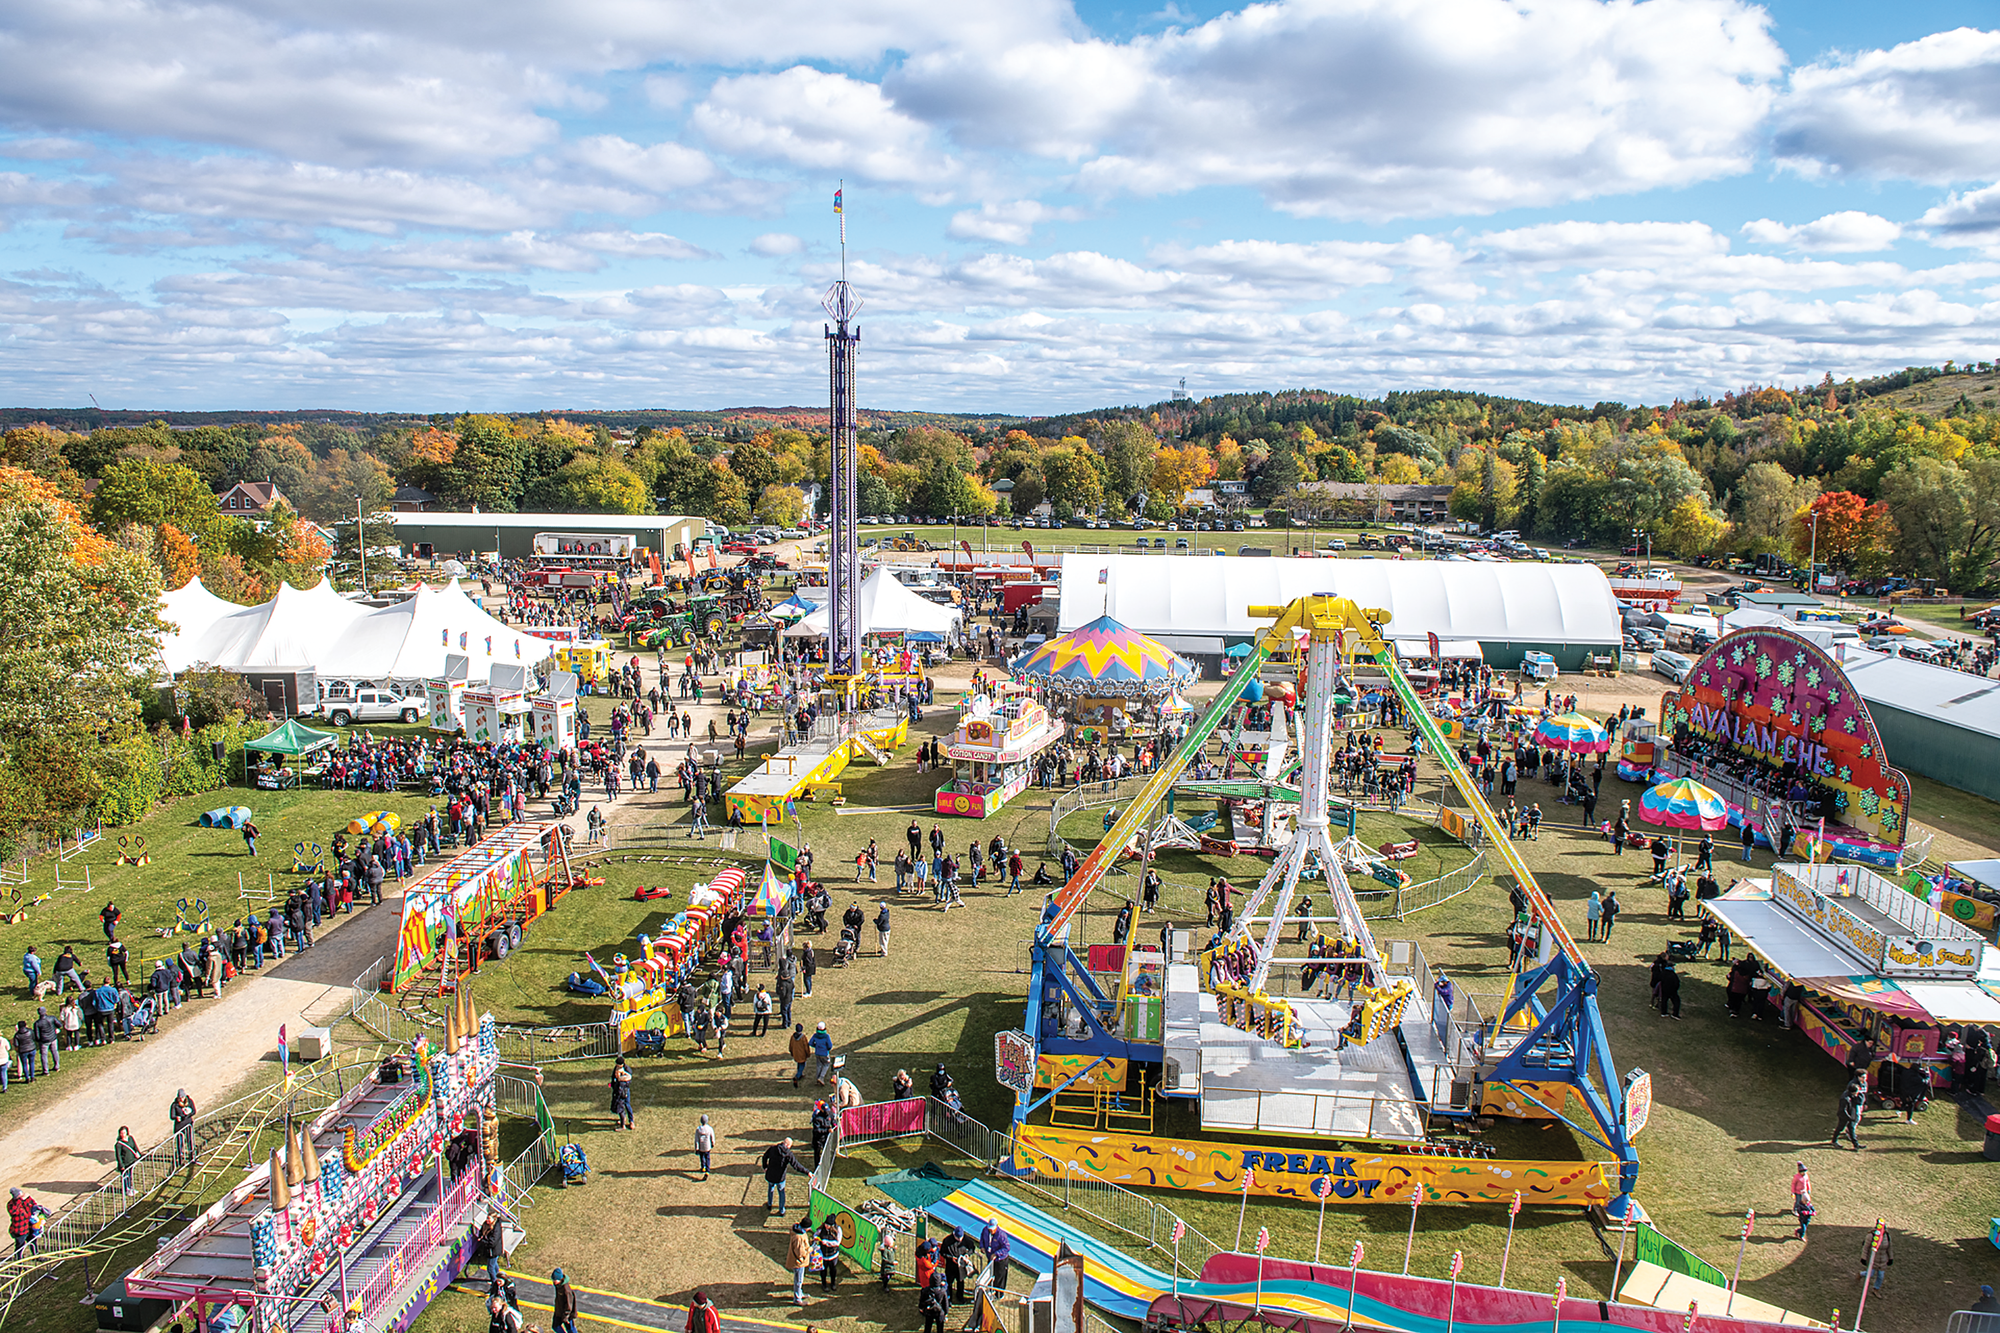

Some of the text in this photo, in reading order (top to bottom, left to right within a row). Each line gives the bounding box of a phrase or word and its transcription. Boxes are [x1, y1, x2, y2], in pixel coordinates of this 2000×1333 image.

[534, 701, 554, 709] TICKETS
[1691, 702, 1831, 778] AVALANCHE
[951, 750, 991, 760] COTTON CANDY
[939, 799, 952, 807] SMILE
[1977, 911, 1991, 922] FUN
[1240, 1150, 1357, 1177] FREAK
[1310, 1178, 1381, 1198] OUT
